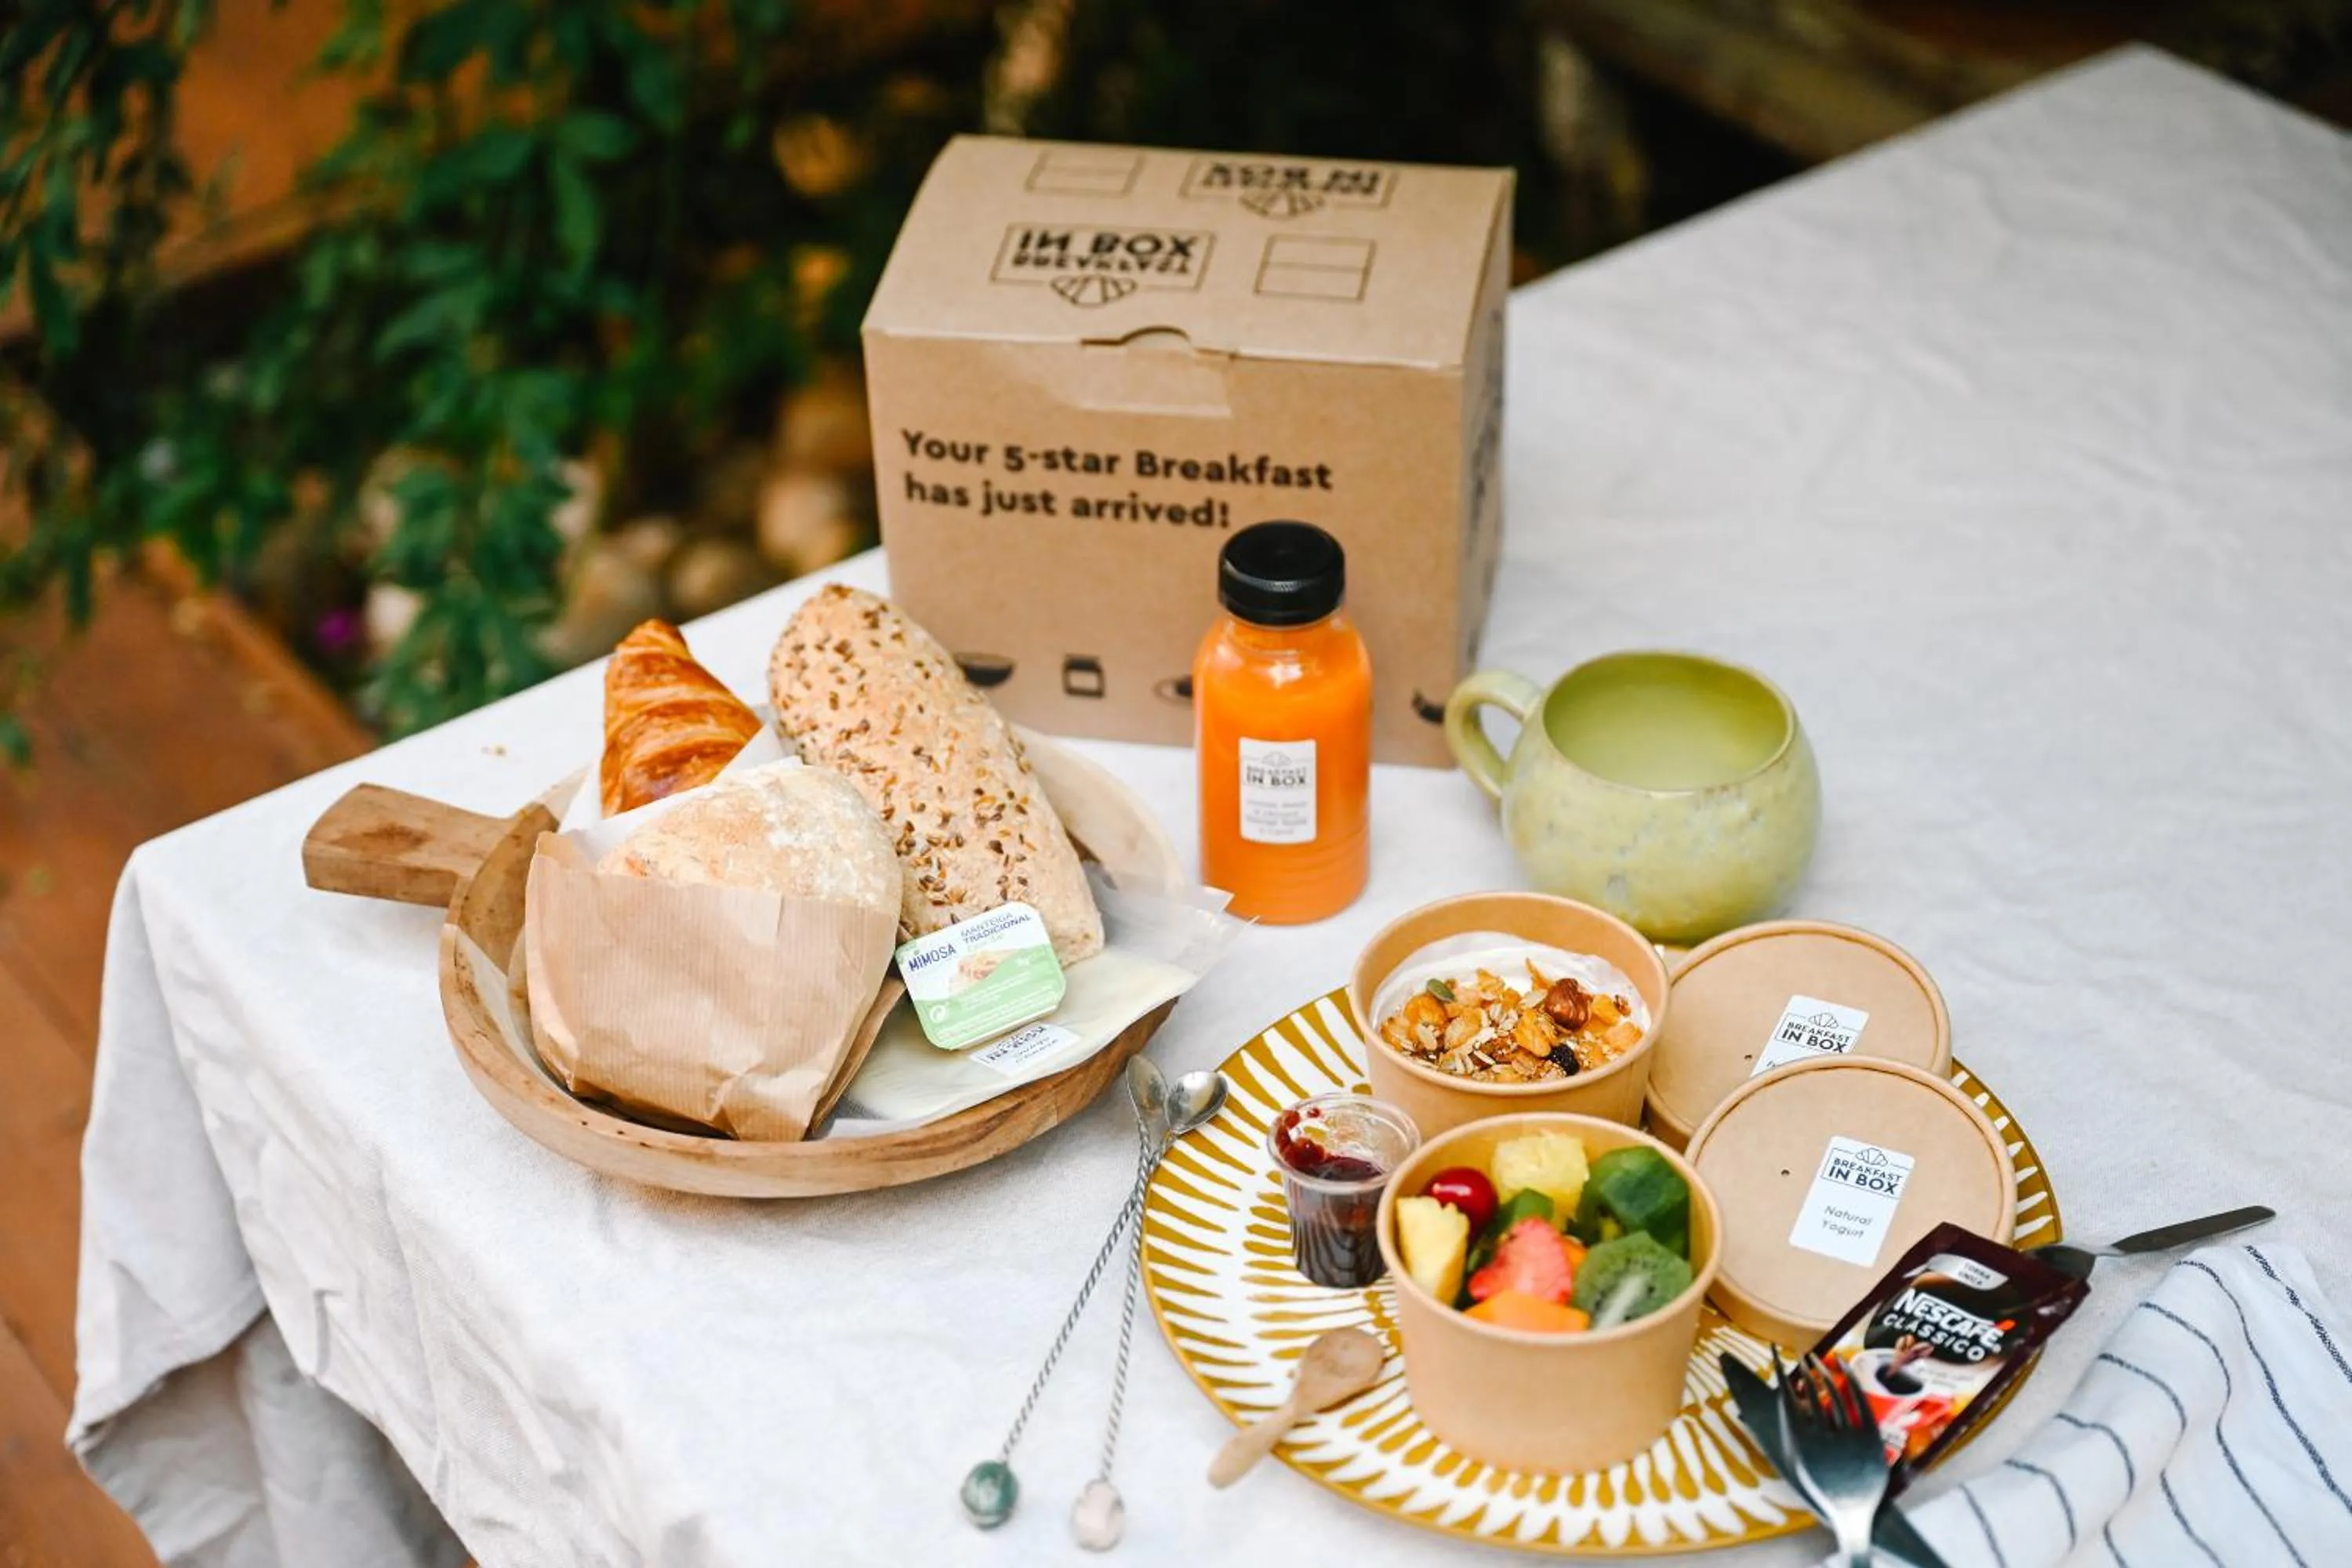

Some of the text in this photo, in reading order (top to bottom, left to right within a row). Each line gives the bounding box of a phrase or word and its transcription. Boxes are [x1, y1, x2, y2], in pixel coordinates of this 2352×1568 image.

[901, 428, 1333, 491] Your 5-star Breakfast
[904, 470, 1230, 528] has just arrived!
[964, 914, 1033, 943] TRADICIONAL
[908, 943, 957, 972] MIMOSA
[1782, 1029, 1847, 1054] IN BOX
[1787, 1022, 1852, 1044] BREAKFAST
[1828, 1166, 1899, 1195] IN BOX
[1834, 1157, 1903, 1182] BREAKFAST
[1822, 1219, 1864, 1239] Yogurt
[1824, 1206, 1874, 1225] Natural
